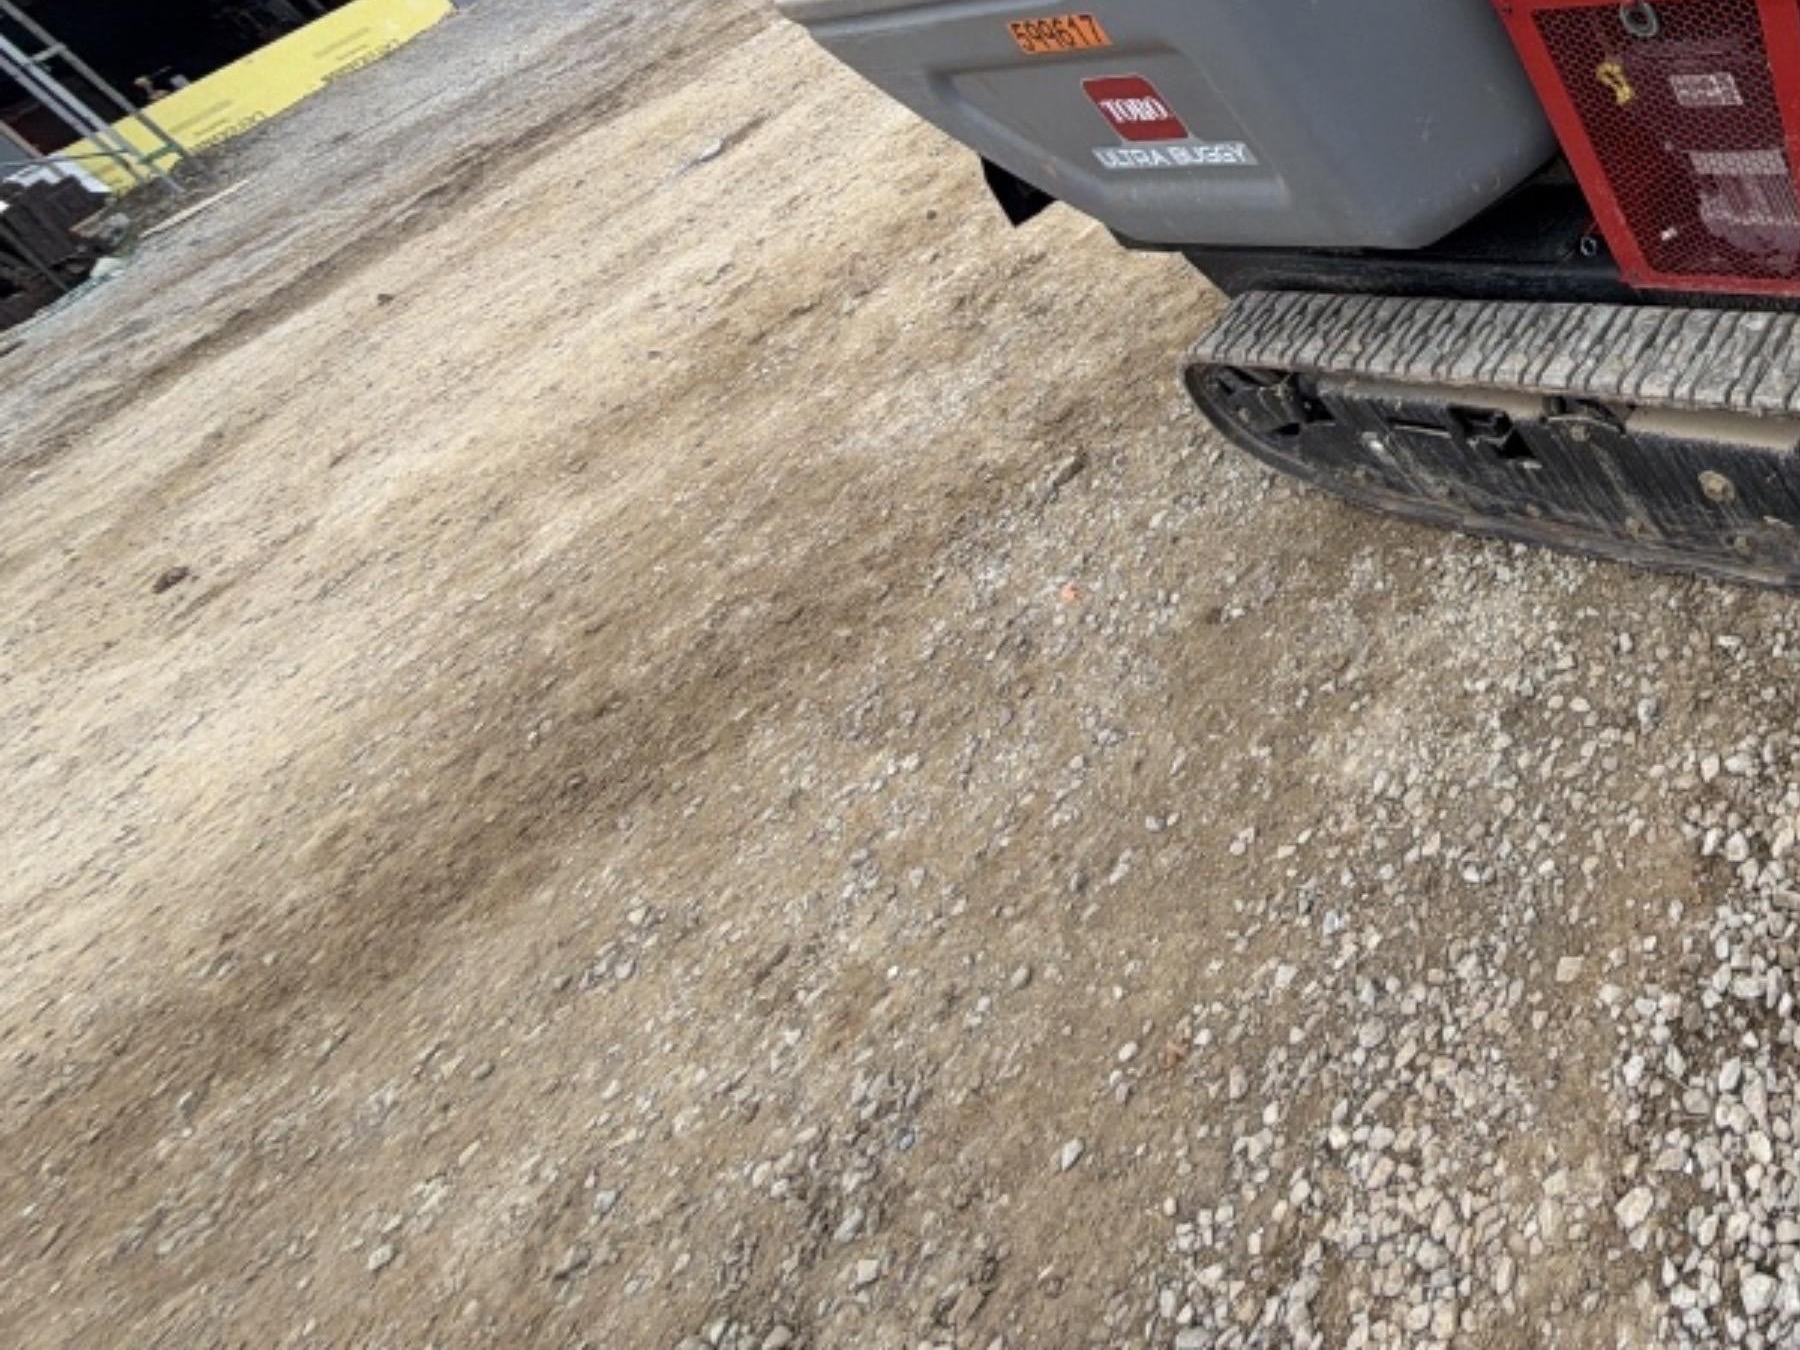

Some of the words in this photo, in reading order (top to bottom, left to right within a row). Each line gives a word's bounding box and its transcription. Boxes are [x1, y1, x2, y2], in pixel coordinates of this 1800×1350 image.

[1009, 13, 1102, 52] 599617
[1095, 147, 1171, 168] ULTRA
[1169, 141, 1248, 166] BUGGY
